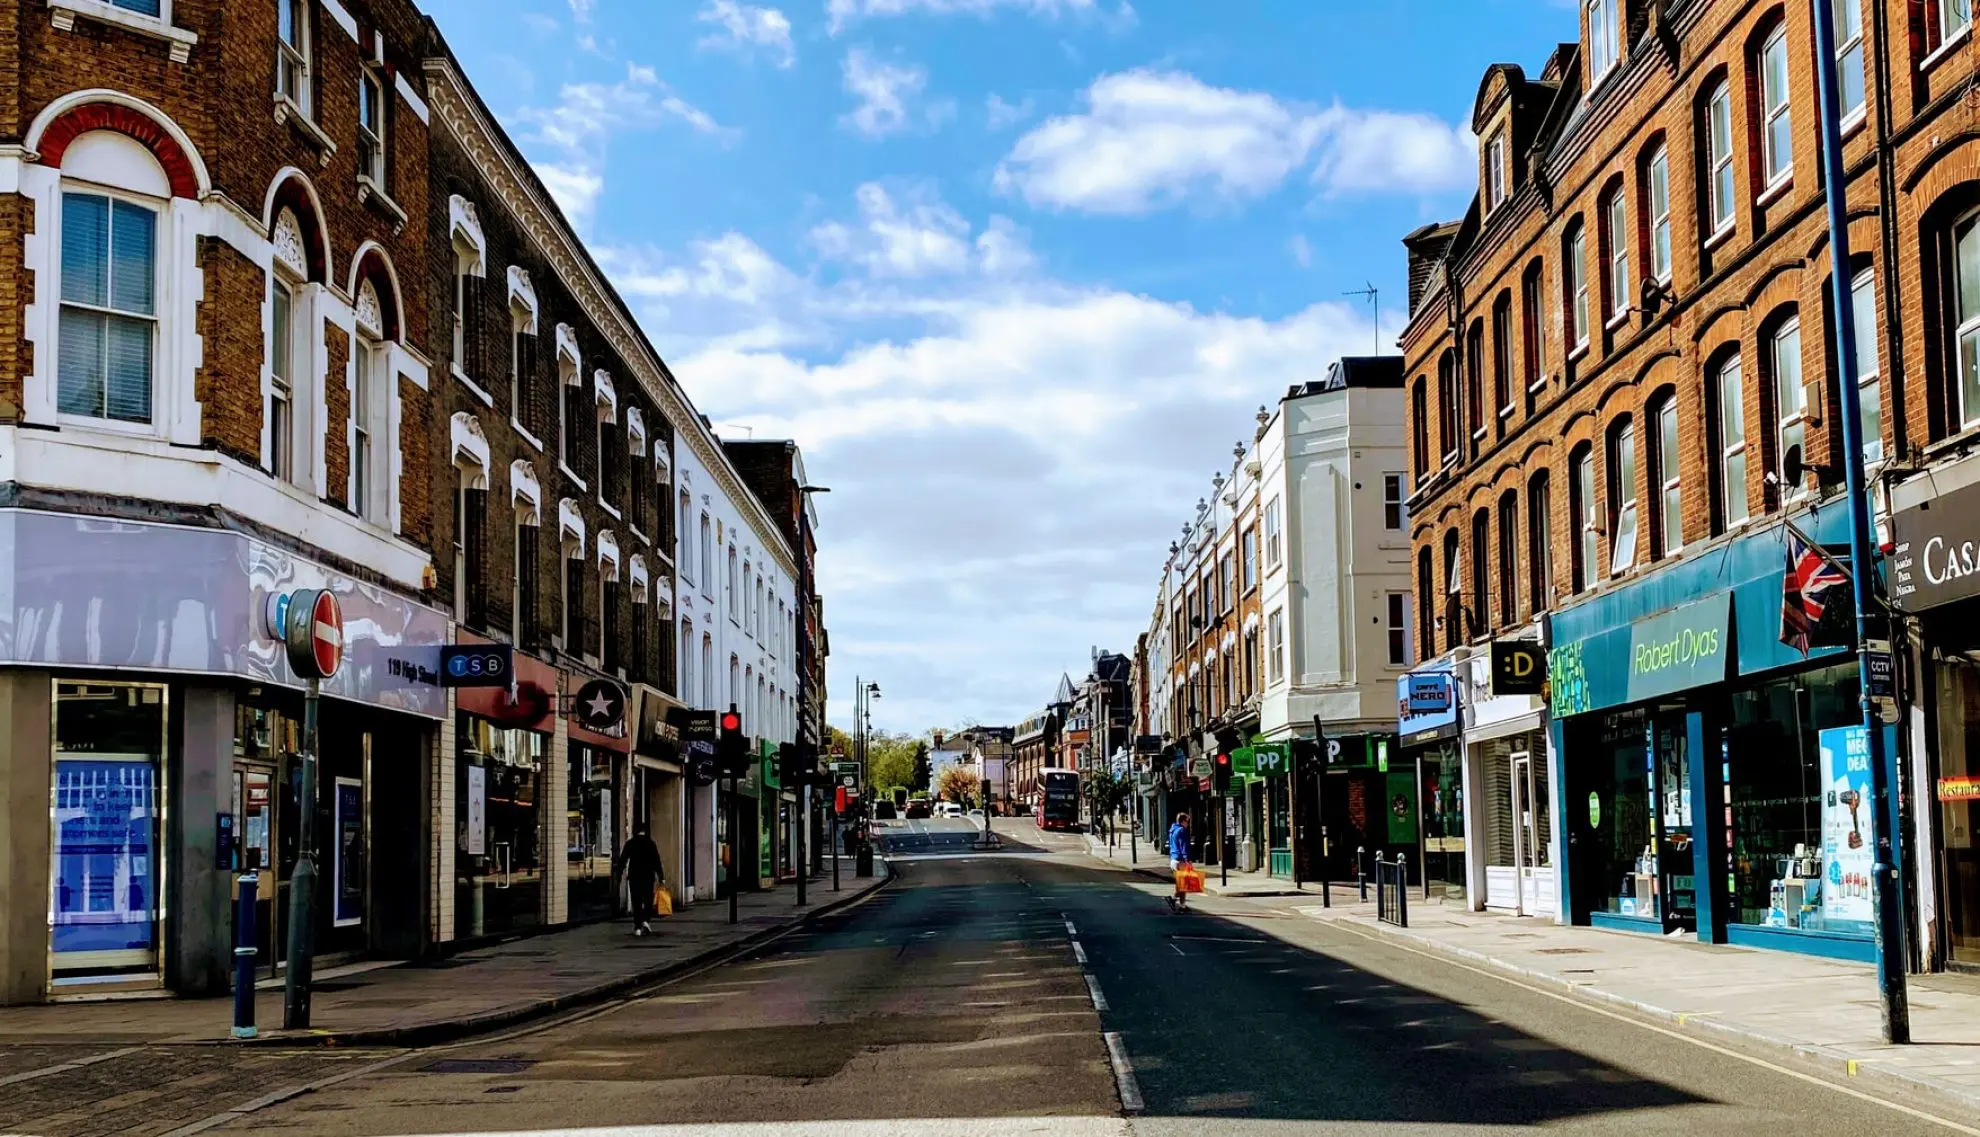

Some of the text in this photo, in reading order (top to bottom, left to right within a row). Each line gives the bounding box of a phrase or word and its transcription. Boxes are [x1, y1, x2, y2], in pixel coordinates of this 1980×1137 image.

[1923, 536, 1980, 585] CAS
[1634, 628, 1719, 676] Robert Dyas
[451, 658, 500, 673] TSB
[1871, 660, 1890, 672] CCTV
[1410, 691, 1446, 701] NERO
[1255, 752, 1280, 771] PP
[1847, 755, 1869, 772] DEA
